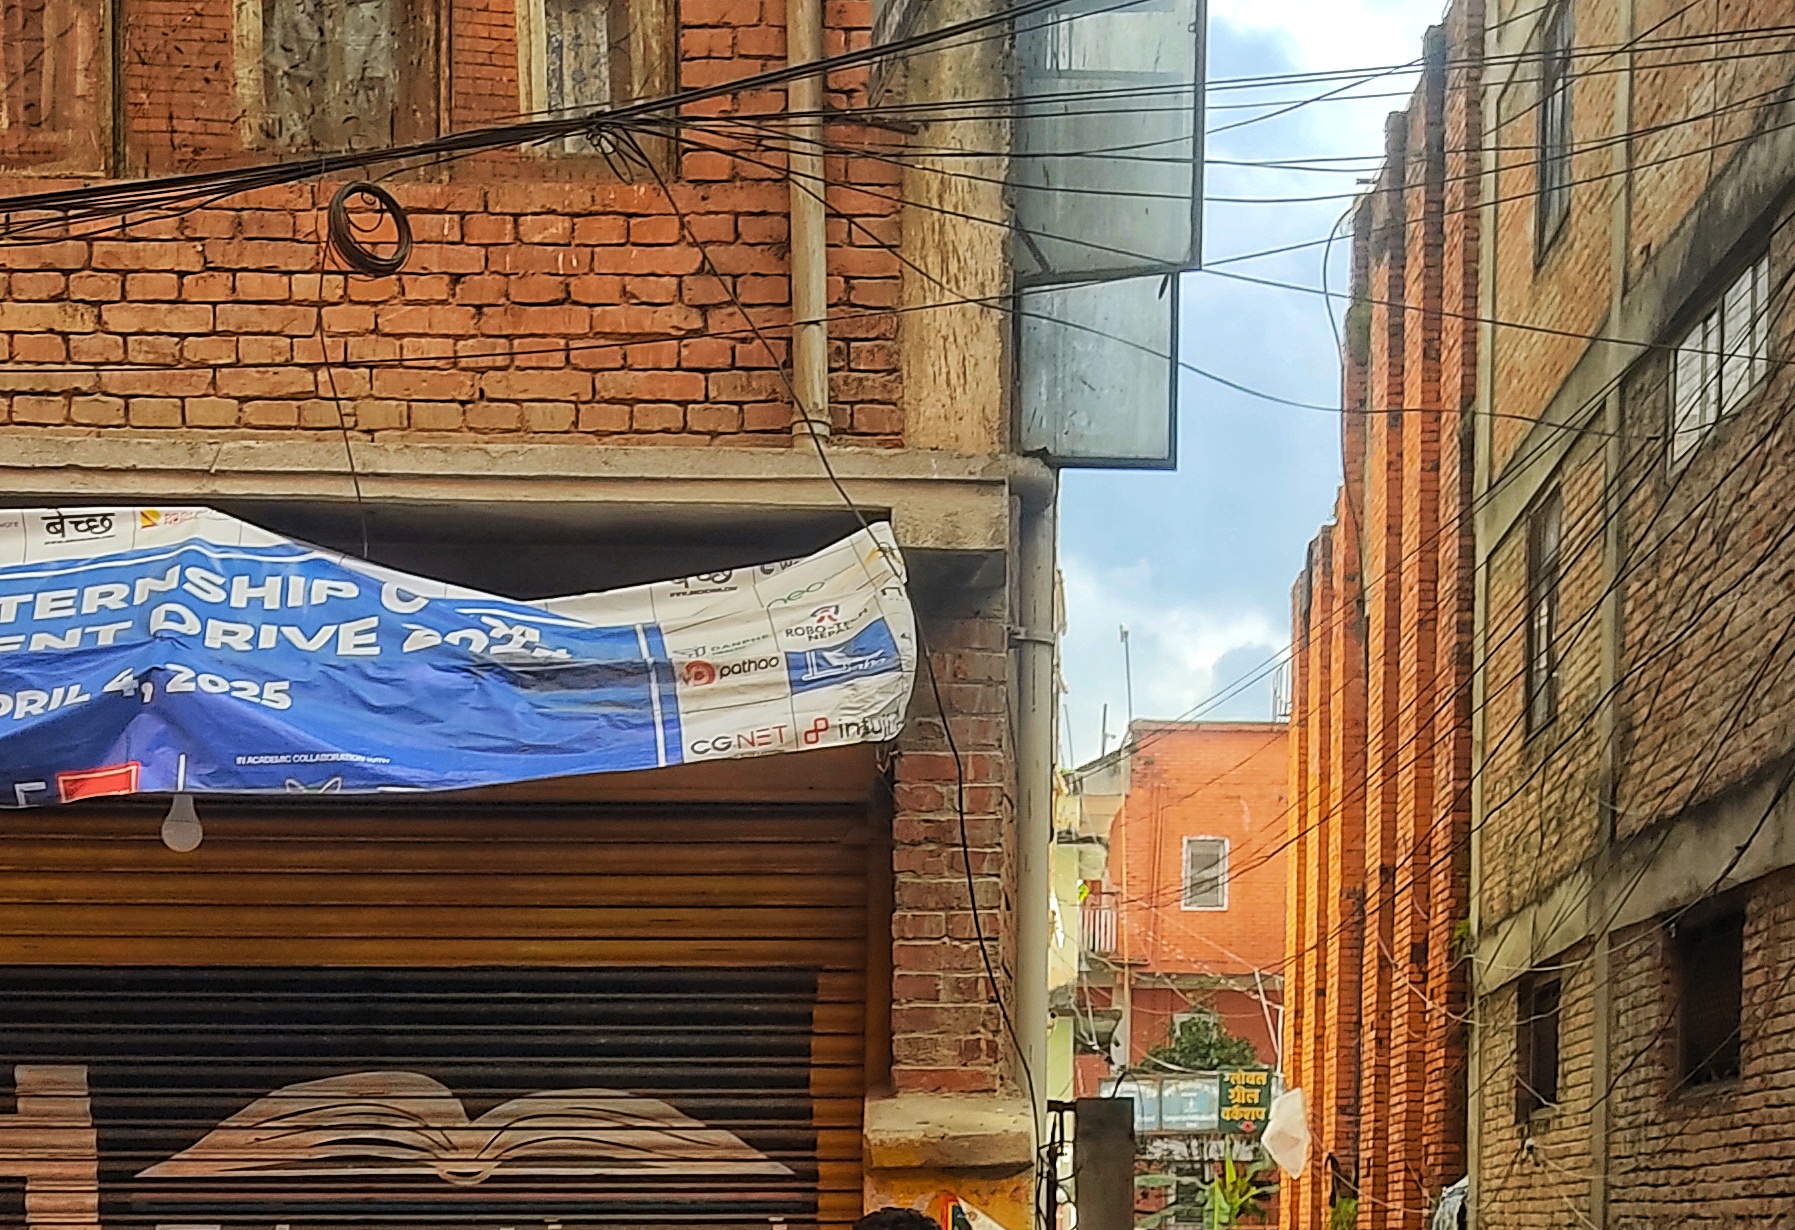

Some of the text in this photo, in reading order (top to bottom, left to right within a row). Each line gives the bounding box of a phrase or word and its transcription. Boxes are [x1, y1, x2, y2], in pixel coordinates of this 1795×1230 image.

[0, 565, 360, 624] TERNSHIP
[150, 604, 381, 656] DRIVE
[165, 664, 292, 710] 2025
[720, 656, 779, 680] pathao
[247, 754, 292, 765] ACADEMIC
[292, 753, 366, 764] COLLABORATION
